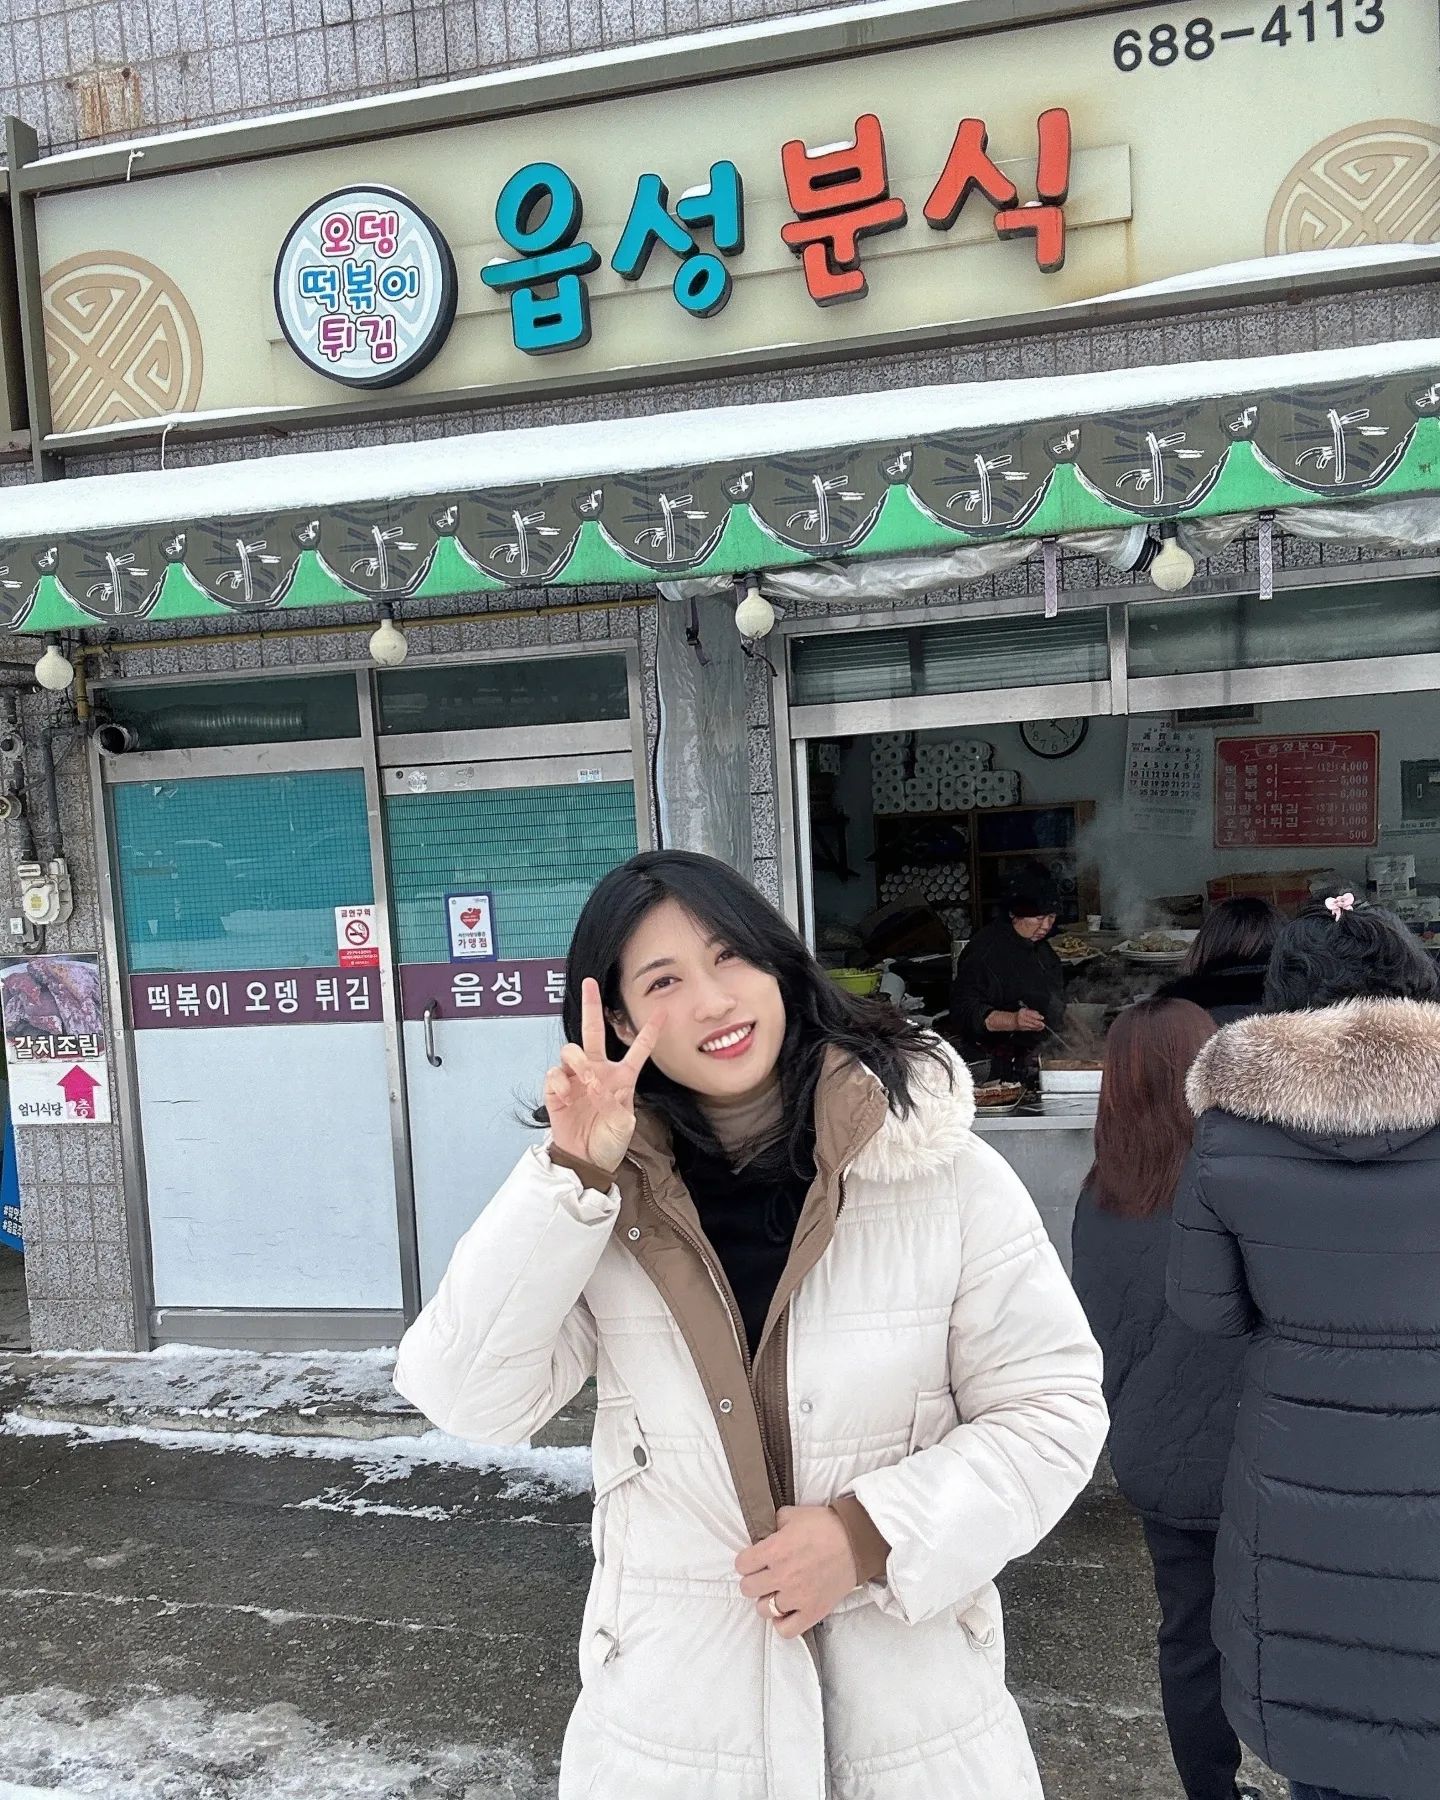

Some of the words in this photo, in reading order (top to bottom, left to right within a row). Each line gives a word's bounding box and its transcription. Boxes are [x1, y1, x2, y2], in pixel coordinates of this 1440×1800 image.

[1113, 0, 1385, 72] 688-4113
[322, 213, 396, 255] 오뎅
[481, 161, 746, 356] 읍성
[781, 108, 1072, 307] 분식
[301, 261, 417, 310] 떡볶이
[321, 318, 394, 359] 튀김
[1340, 761, 1369, 772] 4,000
[1349, 829, 1368, 840] 500
[341, 908, 371, 918] 금연구역
[458, 937, 488, 949] 가맹점
[147, 981, 230, 1018] 떡볶이
[245, 979, 299, 1014] 오뎅
[315, 976, 370, 1012] 튀김
[450, 971, 523, 1008] 읍성
[544, 971, 567, 1003] 분
[14, 1033, 99, 1060] 갈치조림
[18, 1102, 64, 1117] 엄니식당
